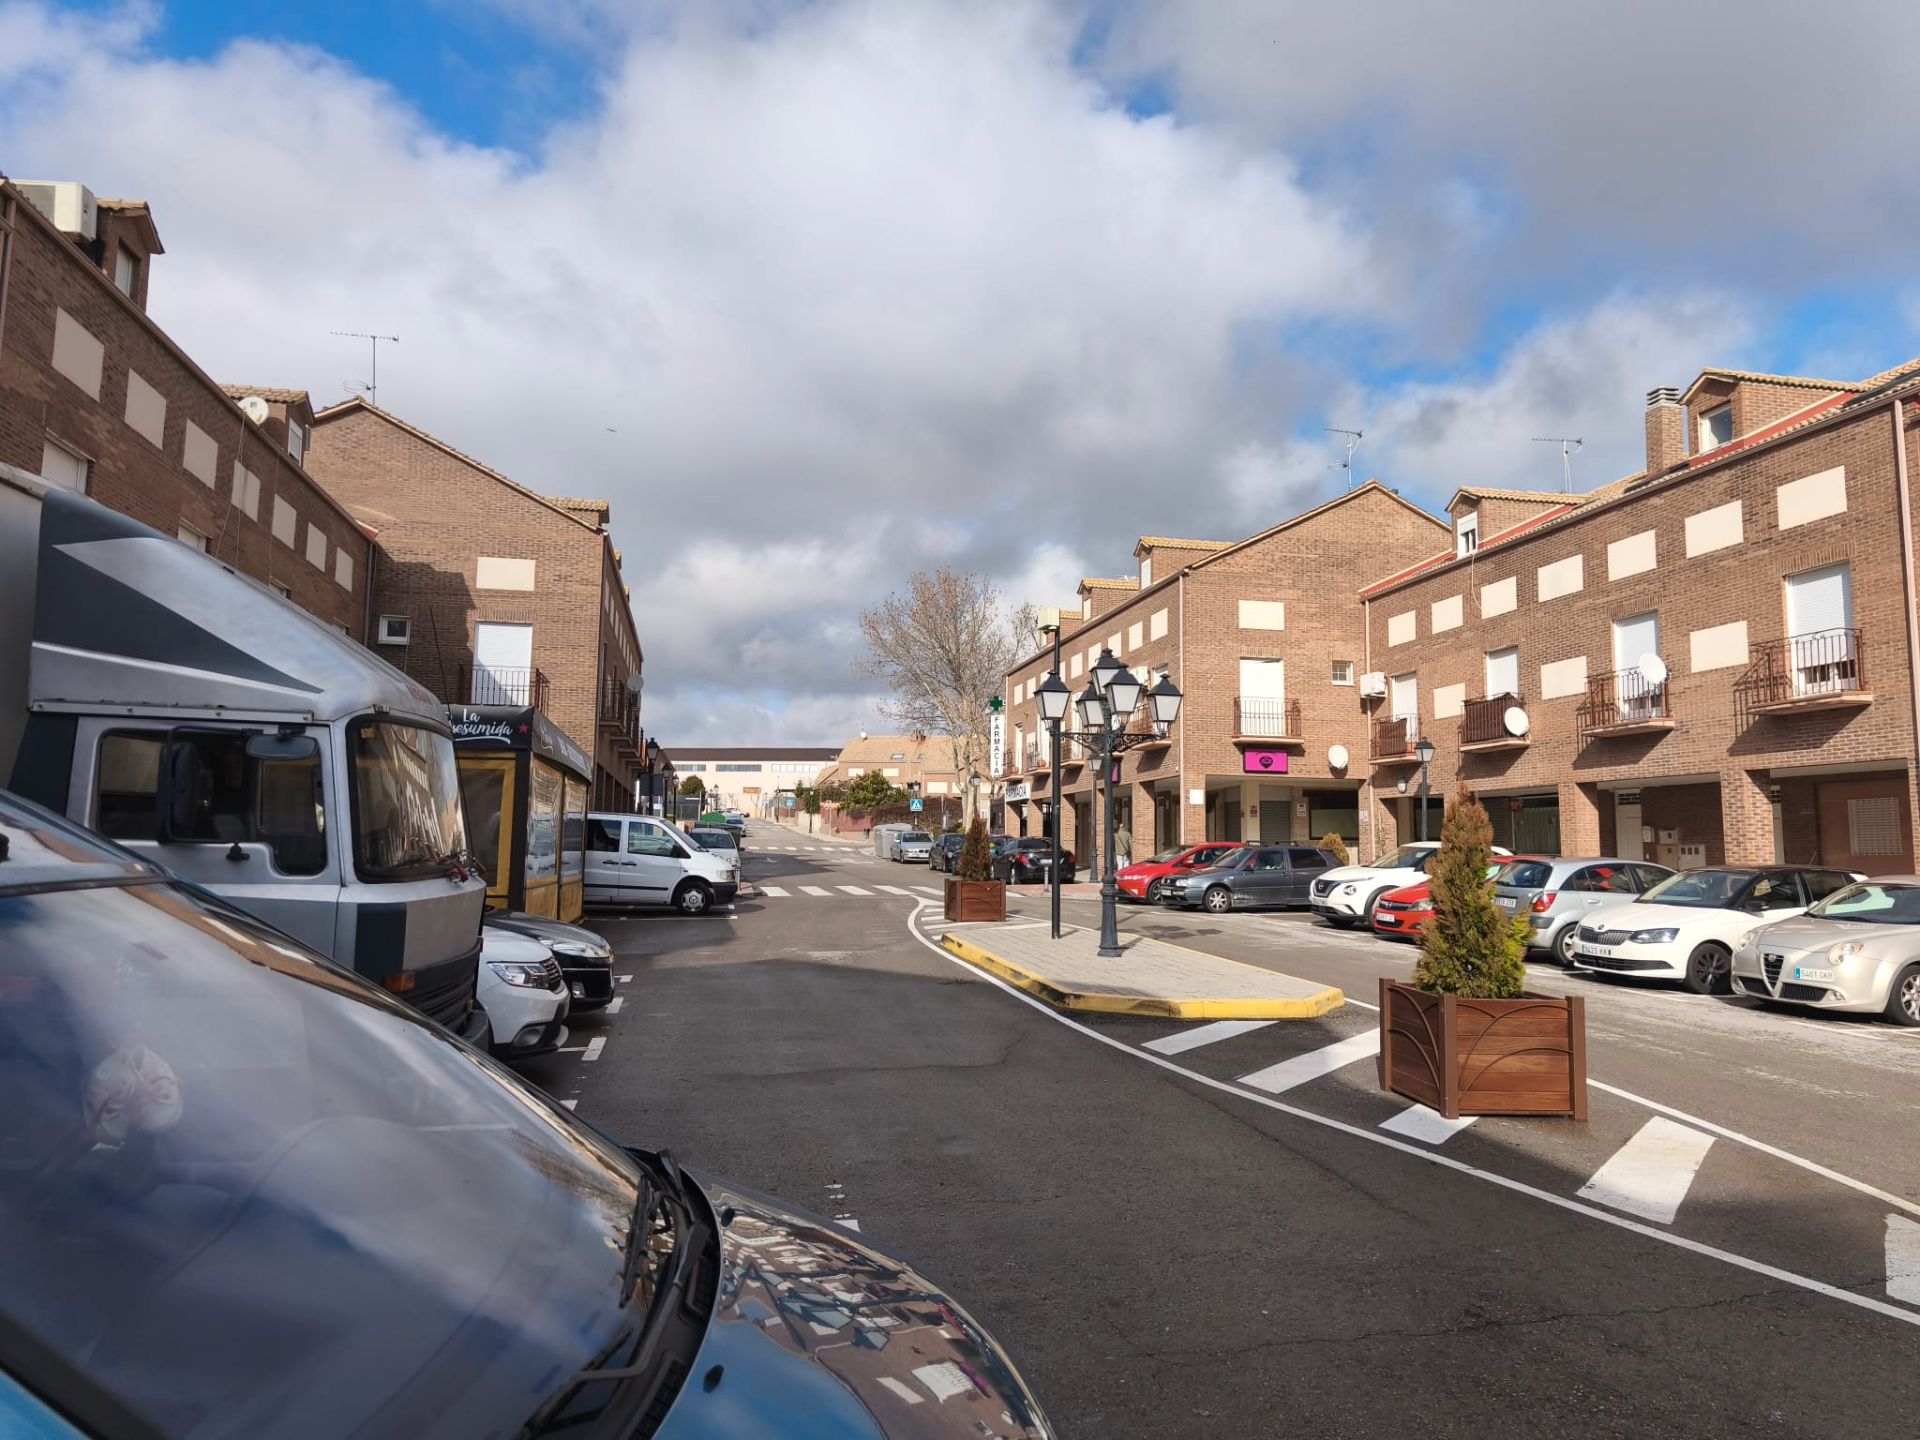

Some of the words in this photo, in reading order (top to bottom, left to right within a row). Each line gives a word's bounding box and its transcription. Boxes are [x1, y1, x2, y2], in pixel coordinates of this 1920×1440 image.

[463, 707, 480, 723] La
[451, 720, 513, 737] resumida
[993, 716, 1001, 774] FARMACIA
